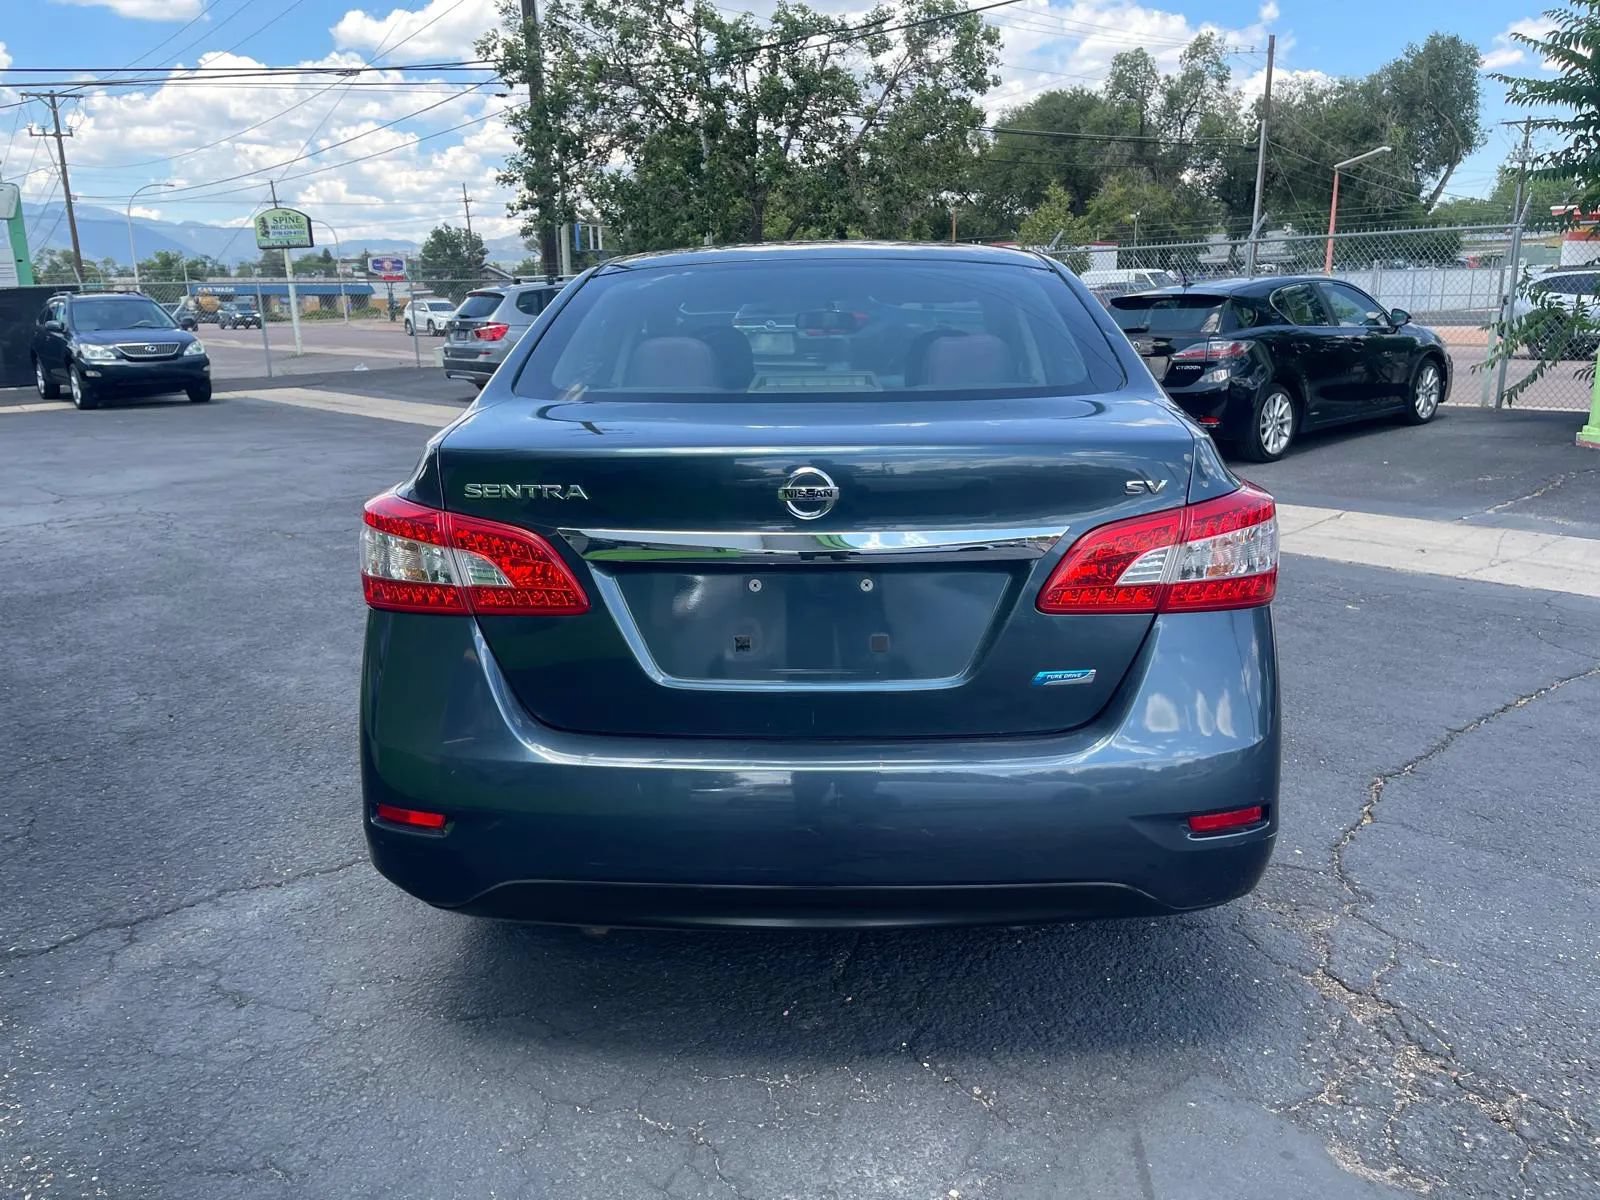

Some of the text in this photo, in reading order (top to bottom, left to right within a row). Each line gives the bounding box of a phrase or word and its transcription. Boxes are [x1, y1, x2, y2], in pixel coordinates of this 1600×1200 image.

[272, 216, 302, 224] SPINE
[464, 483, 589, 500] SENTRA
[784, 489, 833, 498] NISSAN
[1125, 480, 1168, 496] SV
